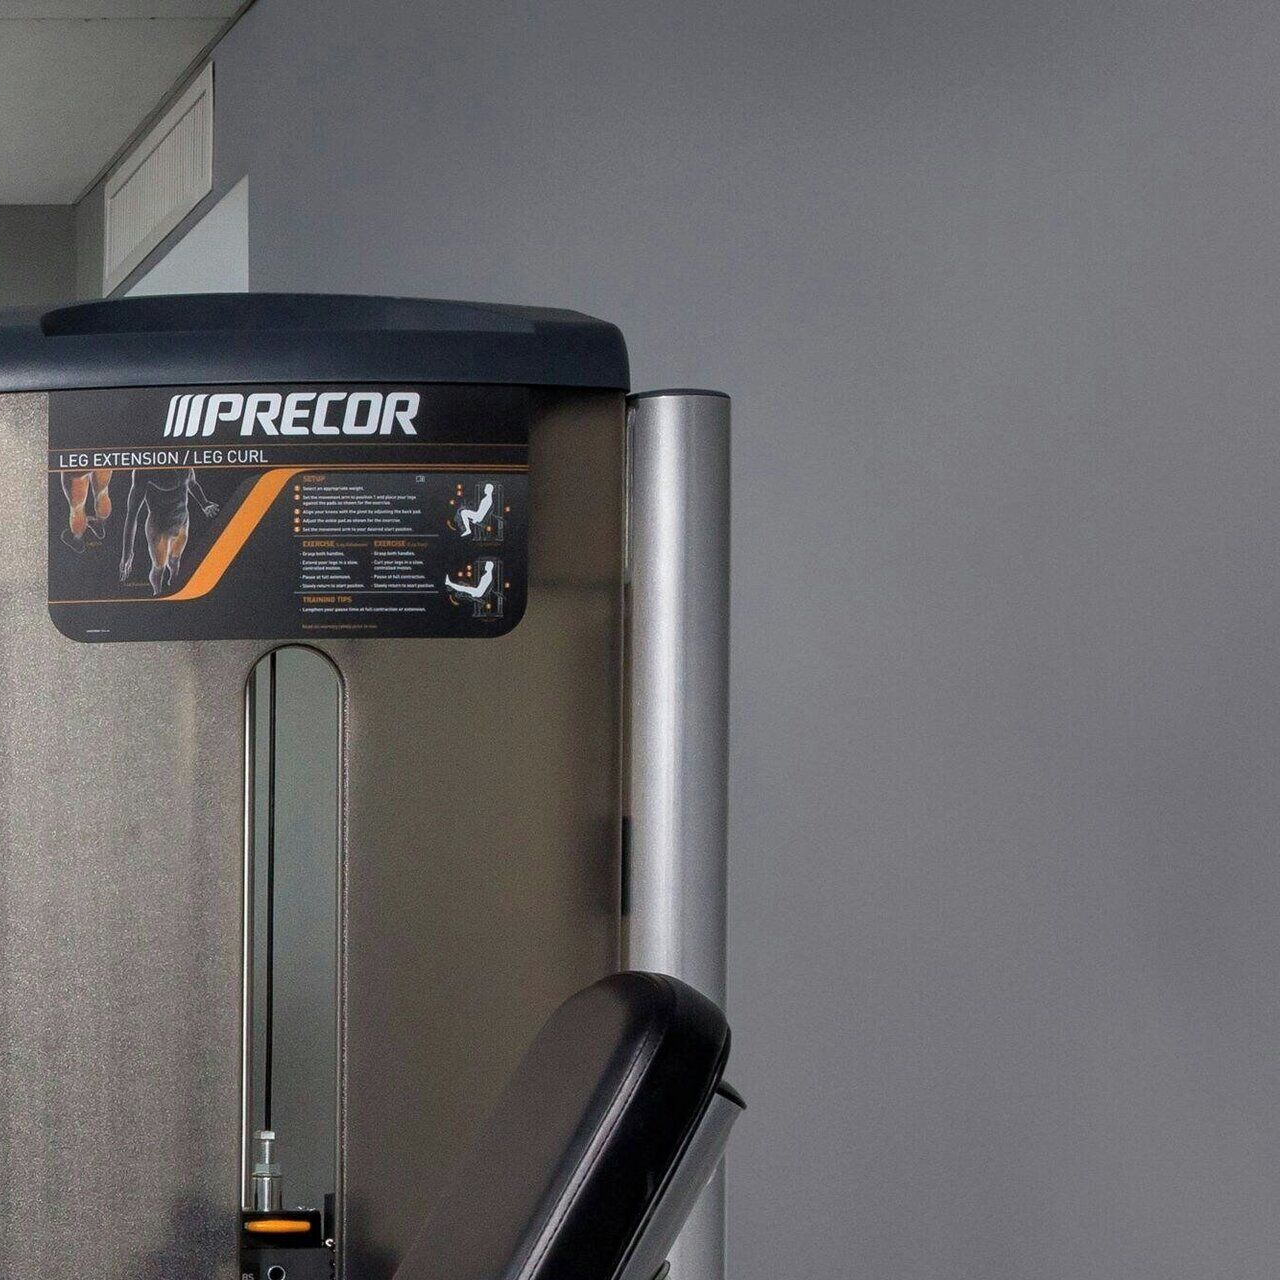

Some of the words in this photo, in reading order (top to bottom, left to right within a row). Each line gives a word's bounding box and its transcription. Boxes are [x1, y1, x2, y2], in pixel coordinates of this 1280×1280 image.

[202, 392, 421, 436] PRECOR
[59, 454, 89, 468] LEG
[93, 451, 179, 466] EXTENSION
[182, 450, 190, 465] /
[194, 450, 223, 464] LEG
[227, 449, 268, 463] CURL
